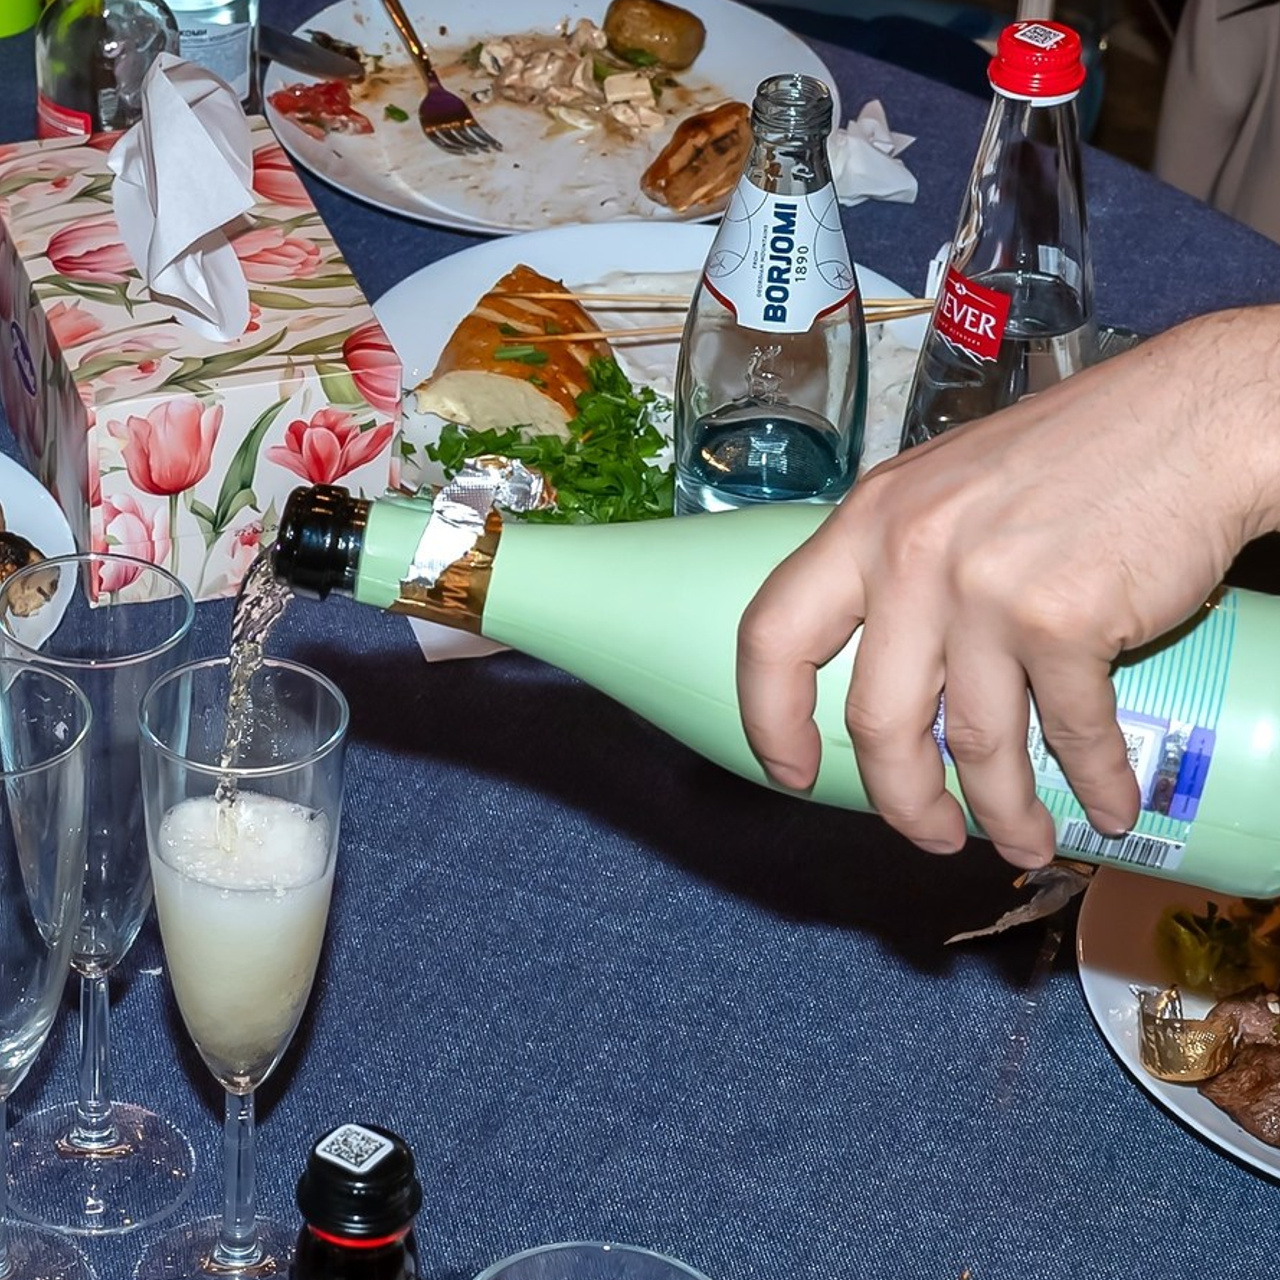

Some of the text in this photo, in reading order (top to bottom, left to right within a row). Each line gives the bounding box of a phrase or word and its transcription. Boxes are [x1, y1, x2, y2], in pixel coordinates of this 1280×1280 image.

[763, 202, 798, 323] BORJOMI
[795, 246, 809, 282] 1890
[940, 290, 997, 340] EVER
